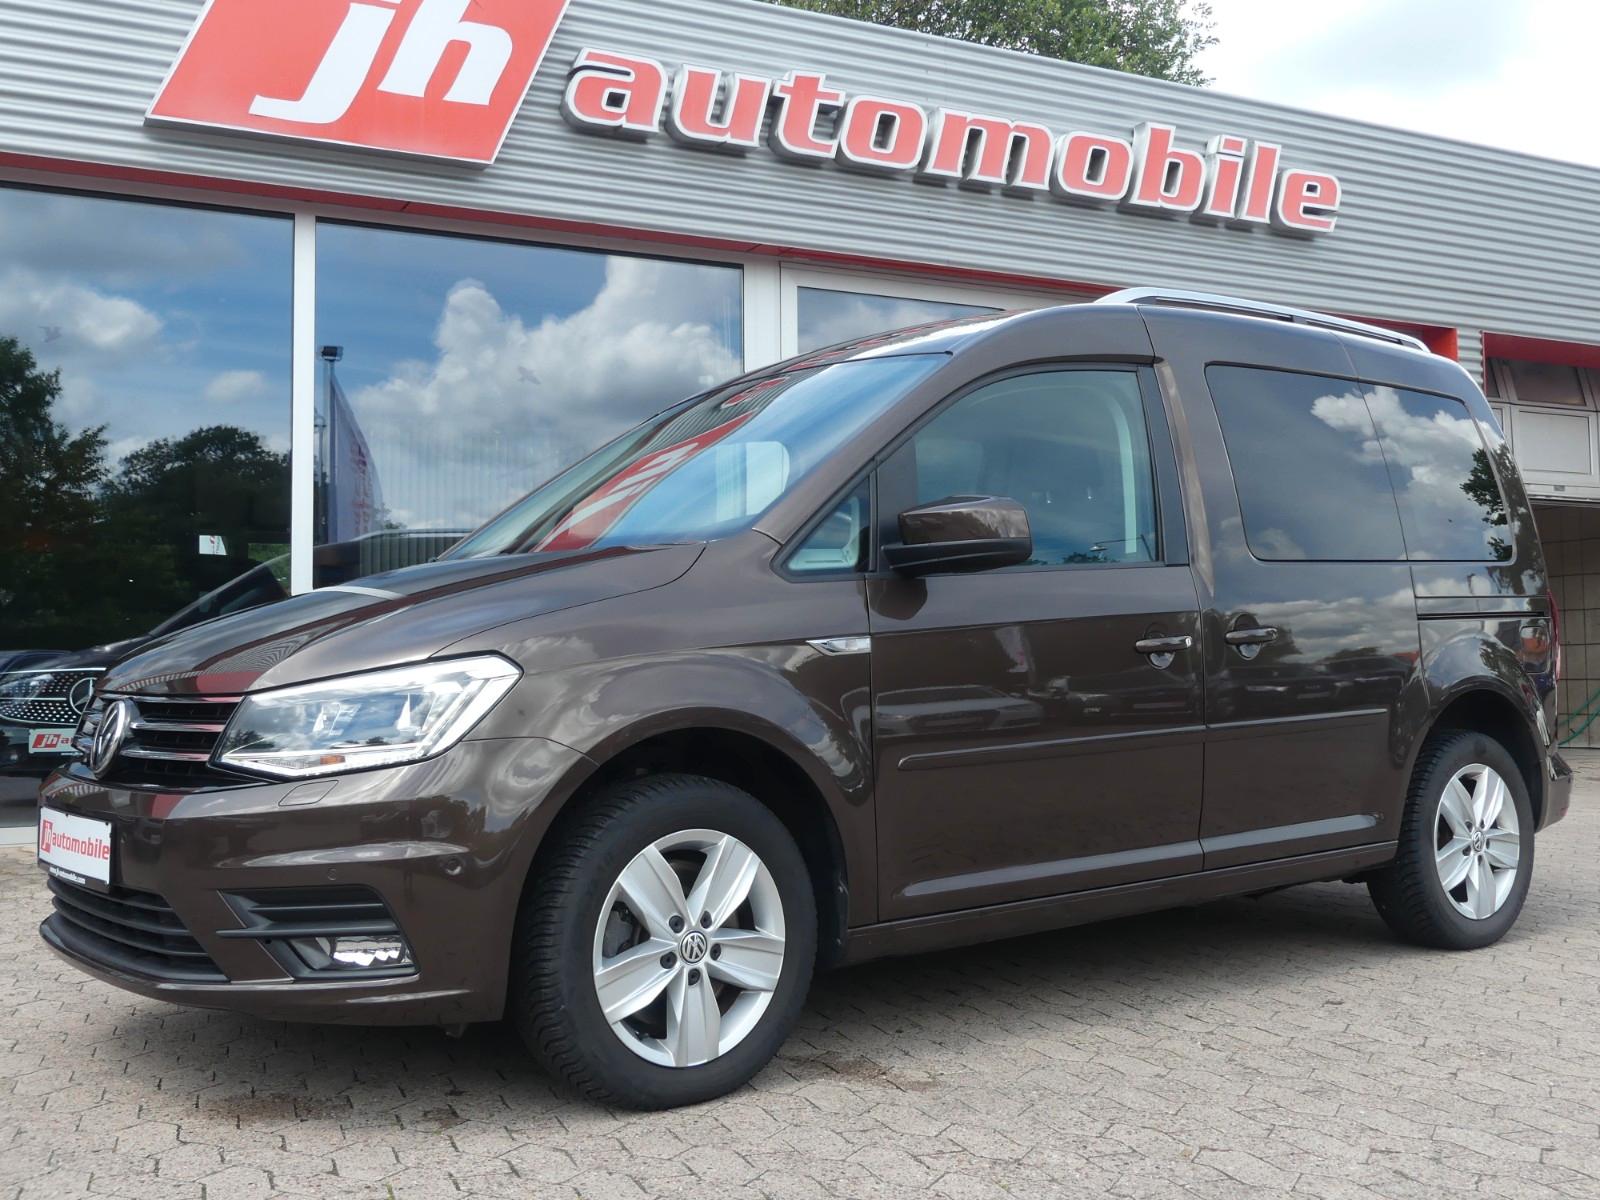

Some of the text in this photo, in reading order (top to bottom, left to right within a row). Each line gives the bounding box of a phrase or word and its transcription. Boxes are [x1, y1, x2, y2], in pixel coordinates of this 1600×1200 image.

[248, 0, 1342, 234] jh automobile
[52, 832, 111, 860] automobile
